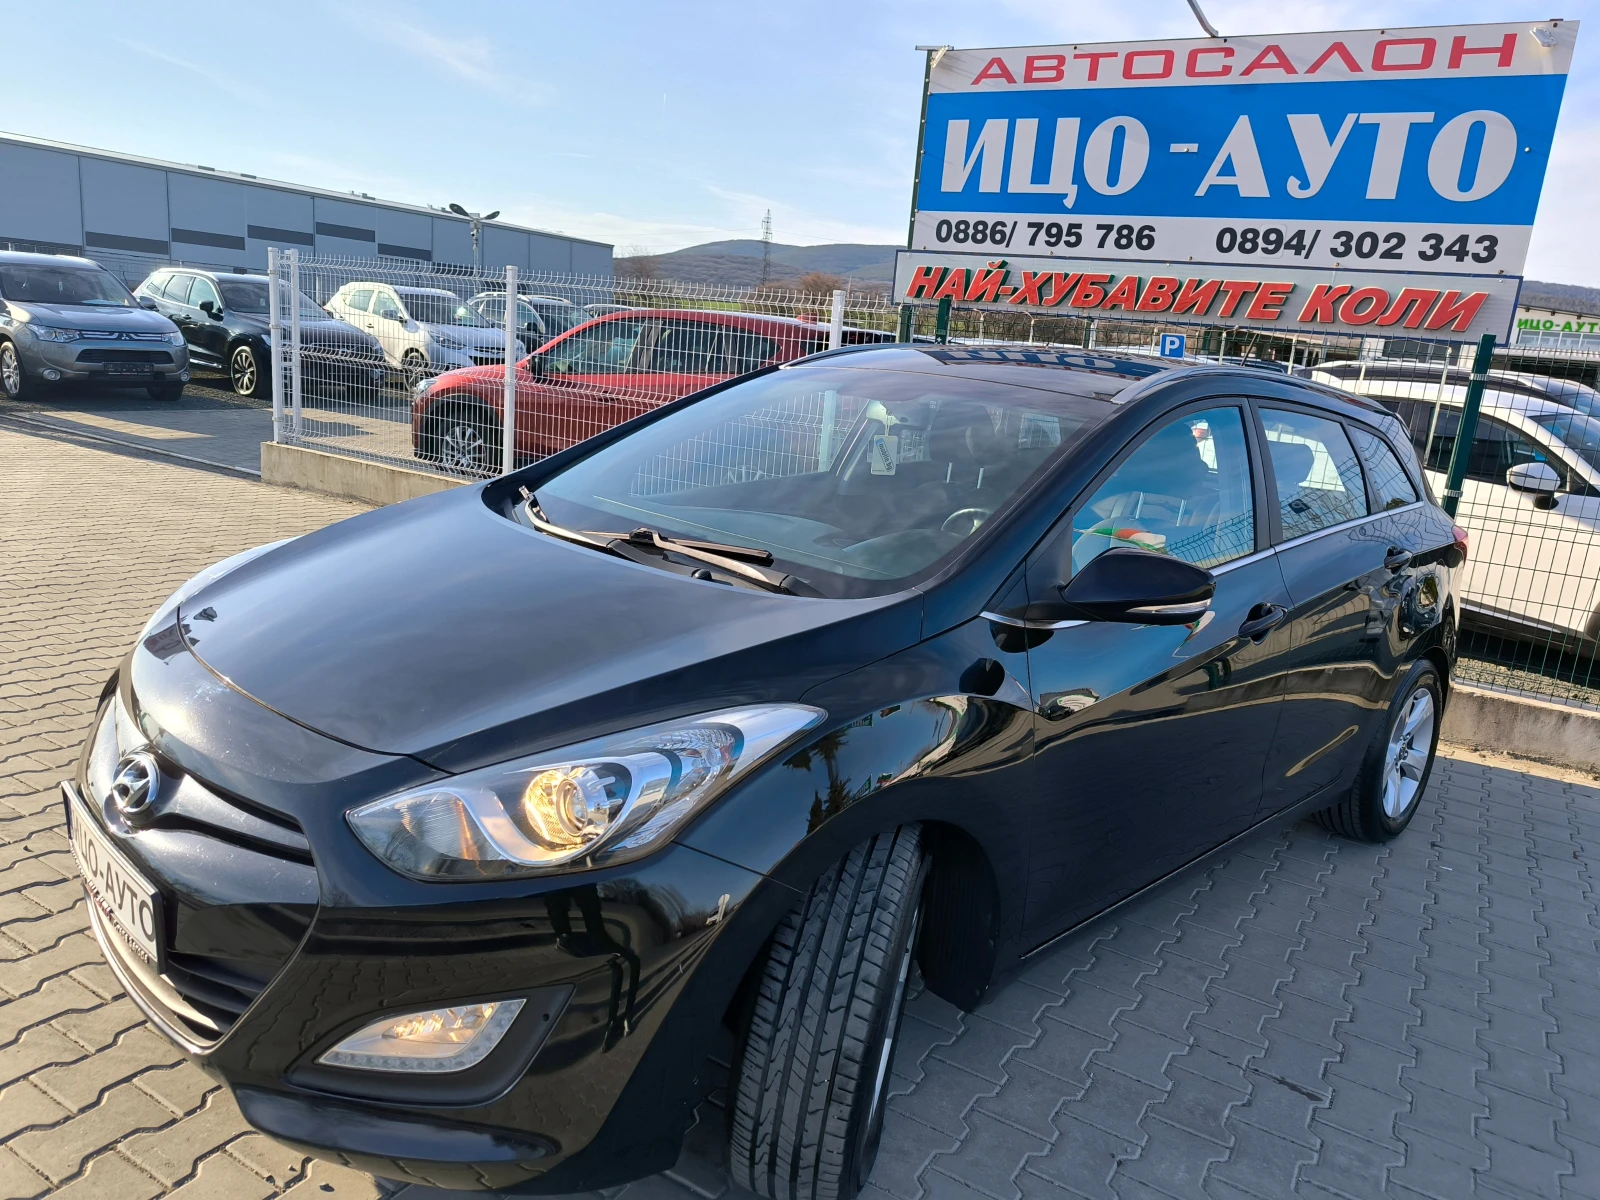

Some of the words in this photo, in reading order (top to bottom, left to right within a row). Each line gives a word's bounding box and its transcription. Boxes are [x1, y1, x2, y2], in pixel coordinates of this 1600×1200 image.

[970, 33, 1518, 85] АВТОСАЛОН
[934, 219, 1018, 248] 0886/
[1027, 221, 1083, 248] 795
[1096, 223, 1156, 251] 786
[1215, 227, 1322, 260] 0894/
[1329, 230, 1406, 260] 302
[1417, 233, 1499, 264] 343
[905, 260, 1294, 323] НАЙ-ХУБАВИТЕ
[1298, 285, 1489, 332] КОЛИ
[1164, 336, 1180, 355] P
[1517, 318, 1600, 333] ИЦО-АУТ
